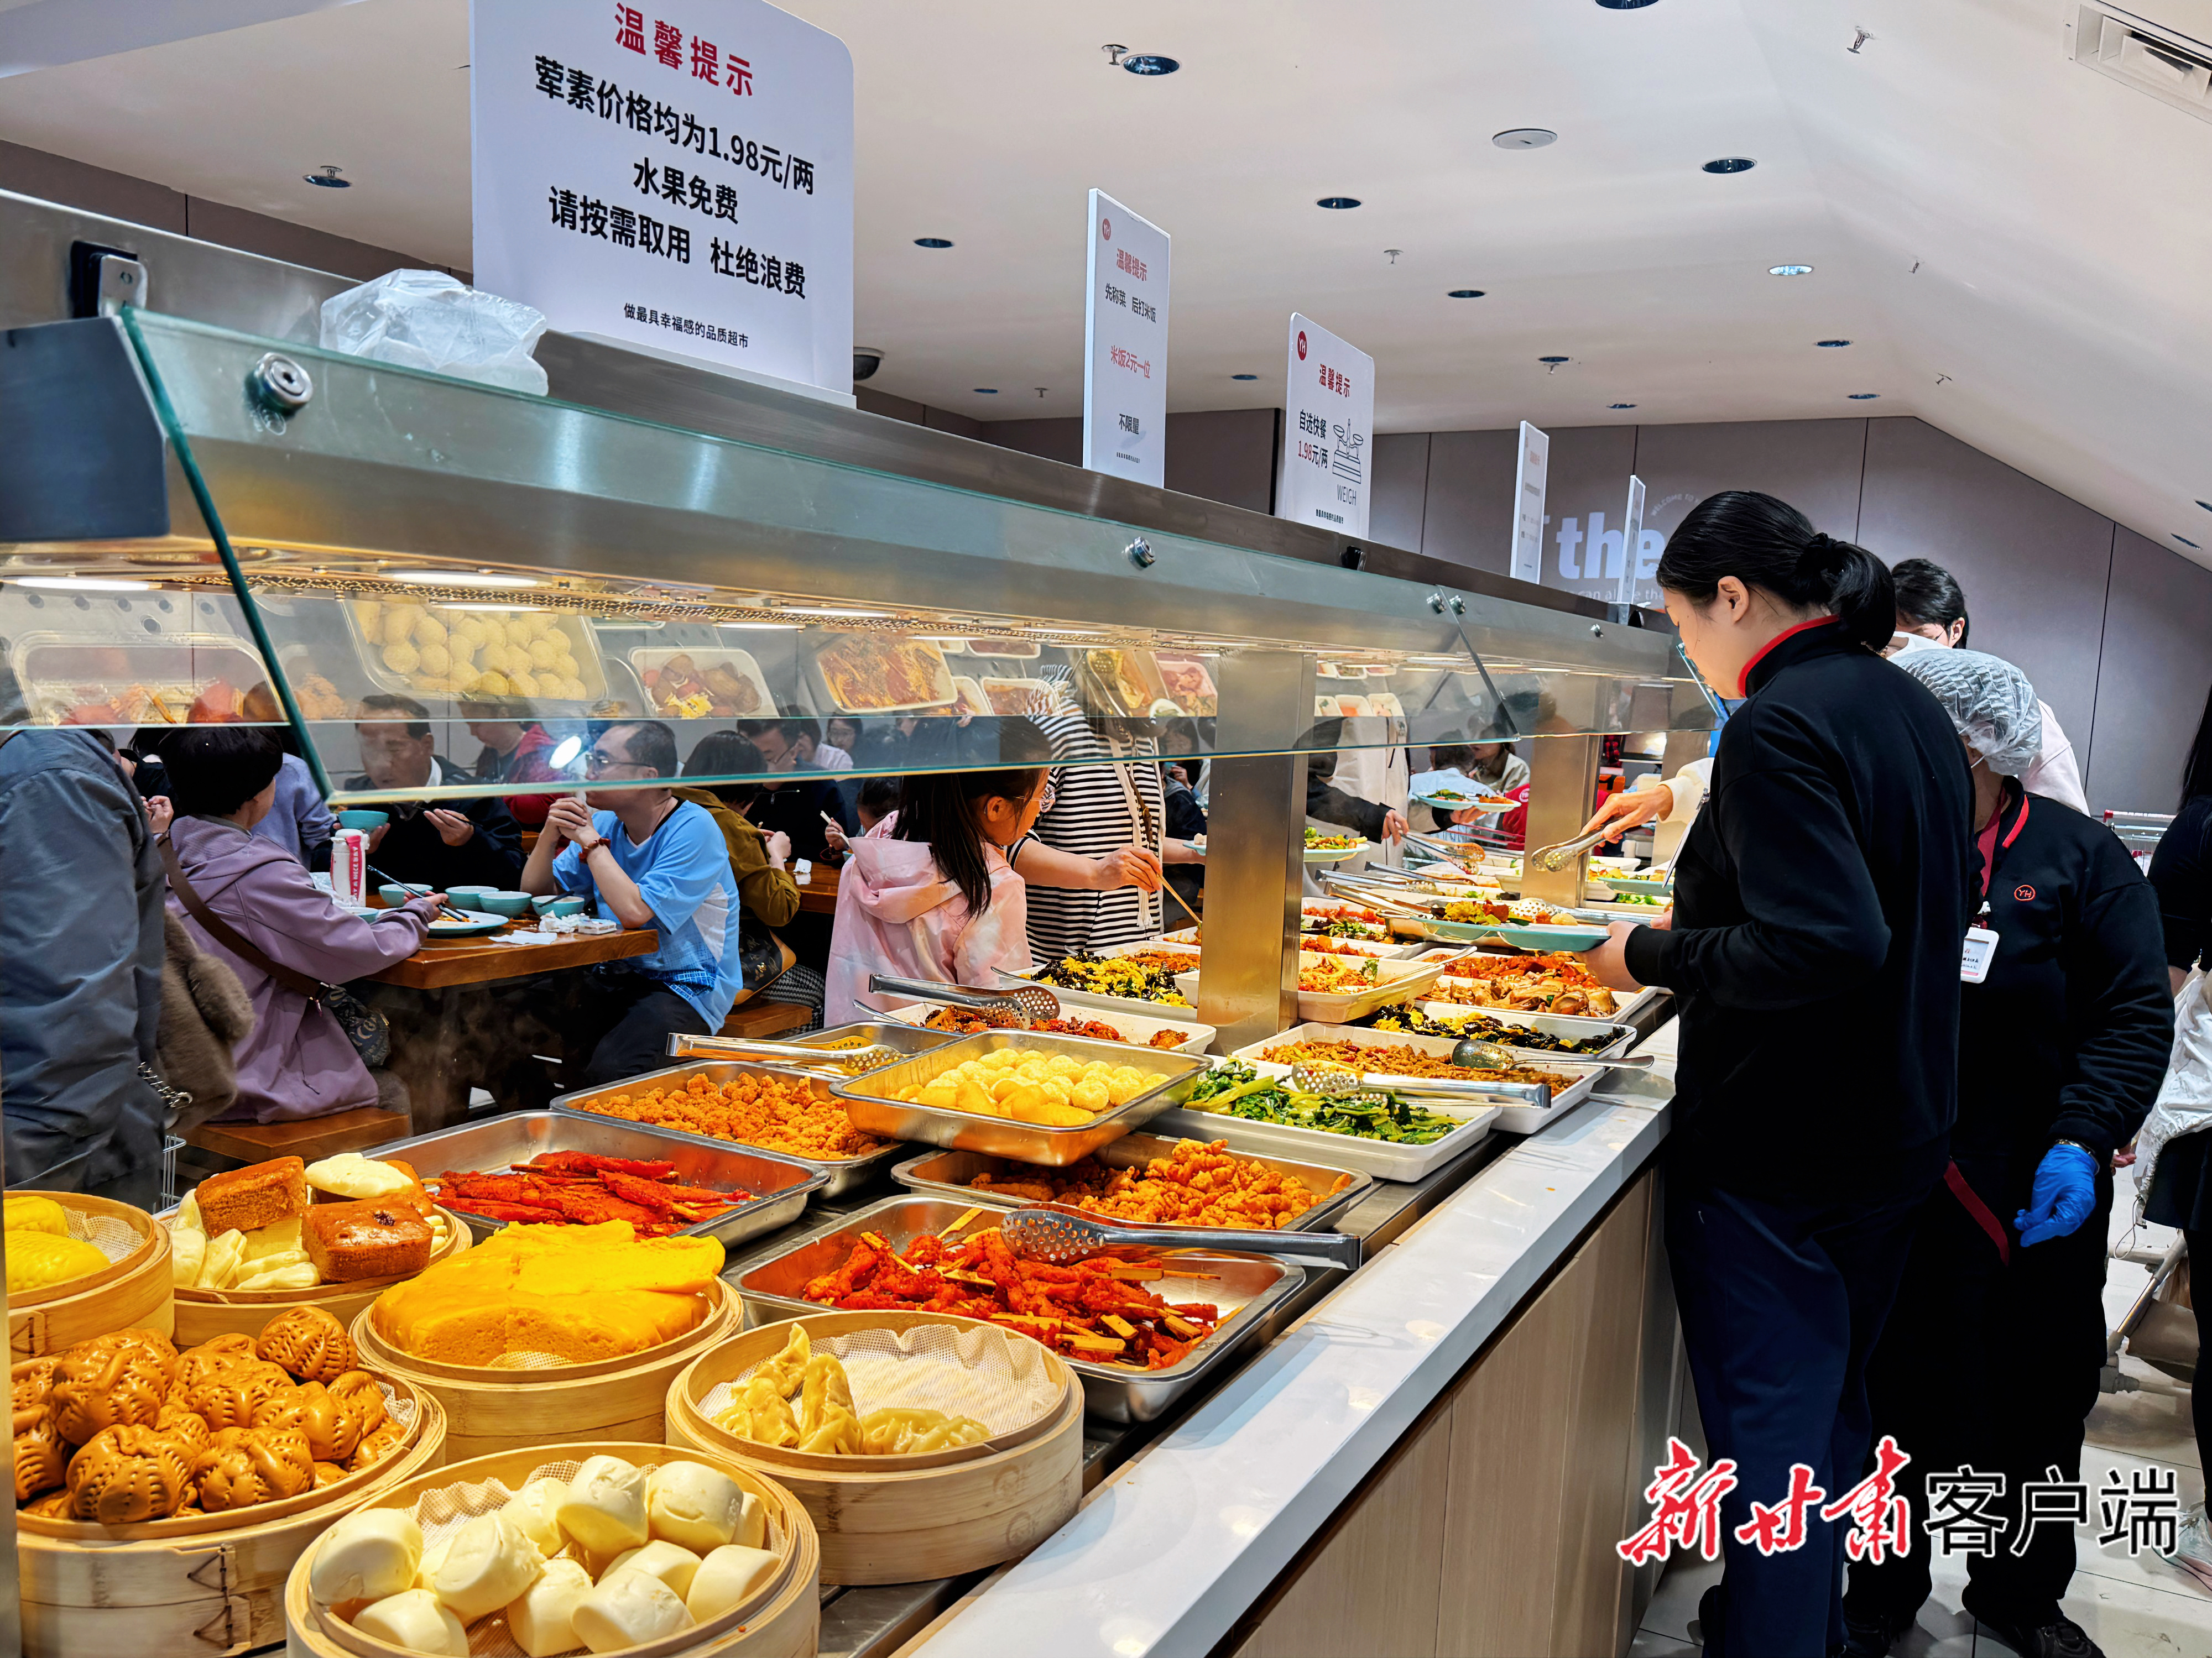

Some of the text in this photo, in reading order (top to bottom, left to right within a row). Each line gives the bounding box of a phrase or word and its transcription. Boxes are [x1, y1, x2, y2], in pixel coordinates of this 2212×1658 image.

[614, 2, 753, 96] 温馨提示
[535, 55, 814, 195] 荤素价格均为1.98元/两
[633, 156, 738, 225] 水果免费
[549, 185, 806, 300] 请按需取用 杜绝浪费
[1117, 248, 1147, 281] 温馨提示
[1105, 283, 1156, 323] 先称菜 后打米饭
[624, 302, 749, 348] 做最具幸福感的品质超市
[1110, 344, 1151, 379] 米饭2元一位
[1319, 363, 1350, 398] 温馨提示
[1119, 413, 1139, 435] 不限量
[1299, 409, 1327, 440] 自选快餐
[1298, 440, 1328, 469] 1.98元/两
[1337, 484, 1357, 506] WEIGH
[1556, 512, 1665, 579] the
[2018, 889, 2032, 898] YH
